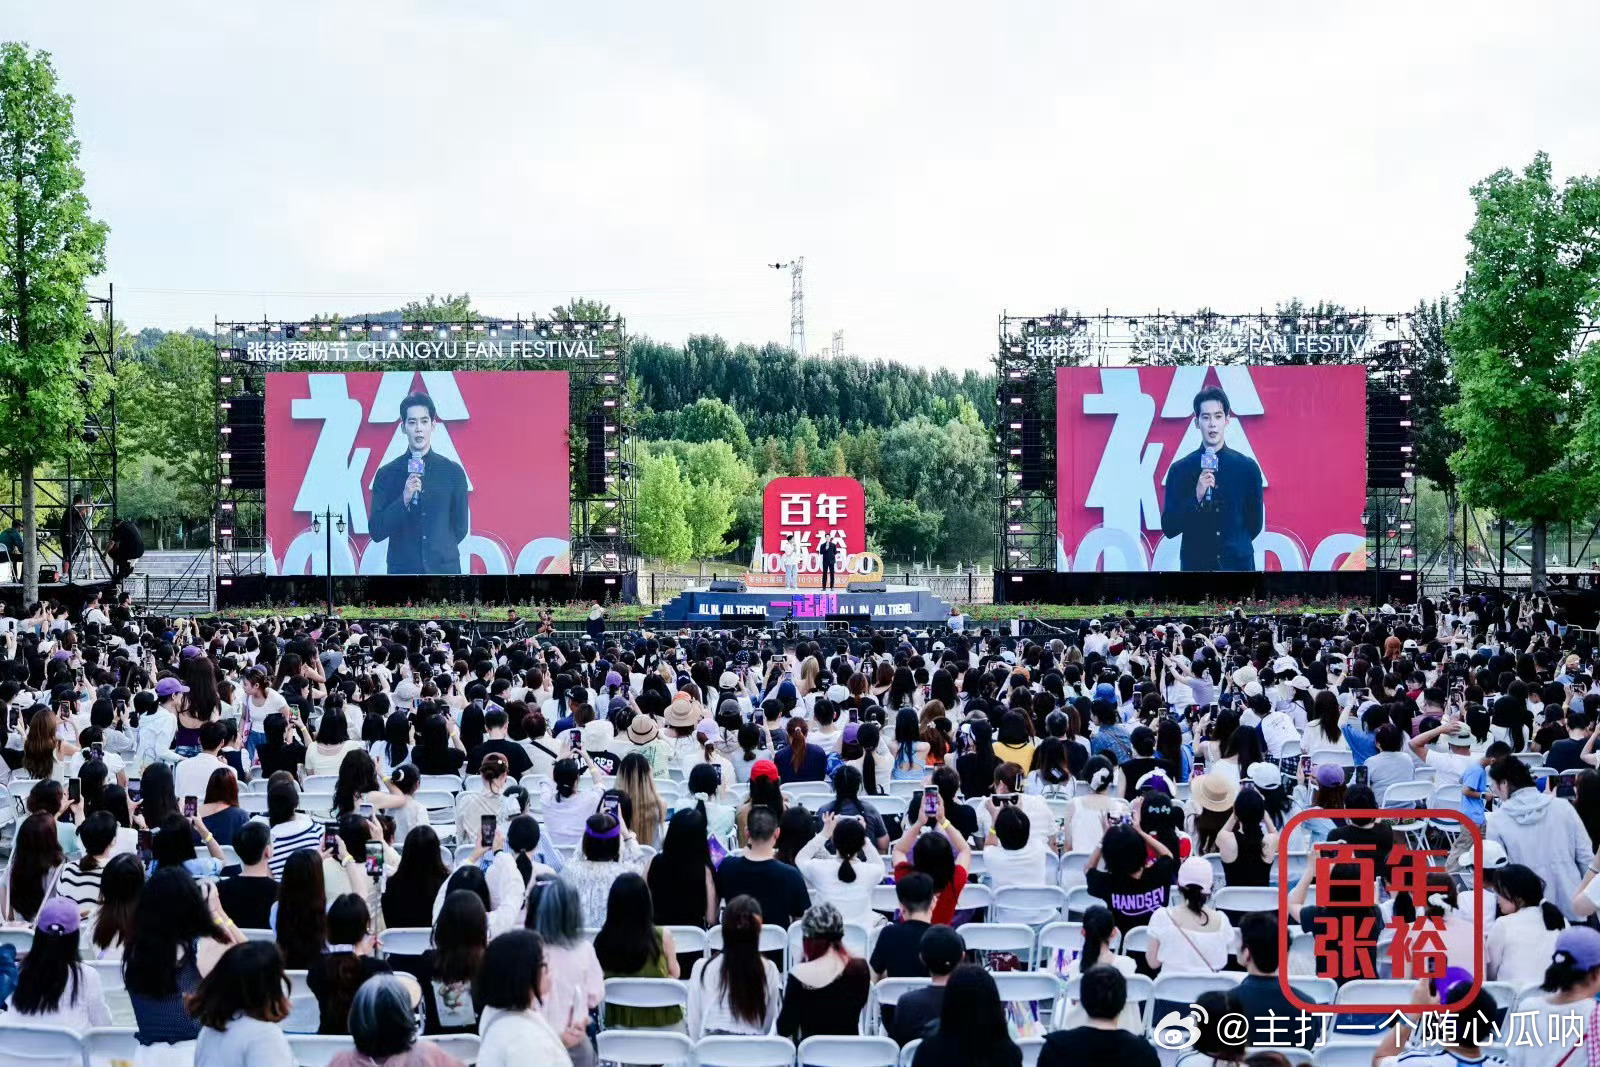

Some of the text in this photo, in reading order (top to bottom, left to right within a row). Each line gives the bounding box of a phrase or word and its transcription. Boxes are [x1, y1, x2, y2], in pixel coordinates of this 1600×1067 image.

[247, 341, 600, 361] 张裕宠粉节 CHANGYU FAN FESTIVAL
[1138, 335, 1242, 353] CHANGYU
[1250, 335, 1287, 352] FAN
[1295, 335, 1386, 352] FESTIVAL
[780, 493, 848, 526] 百年
[699, 603, 710, 615] ALL
